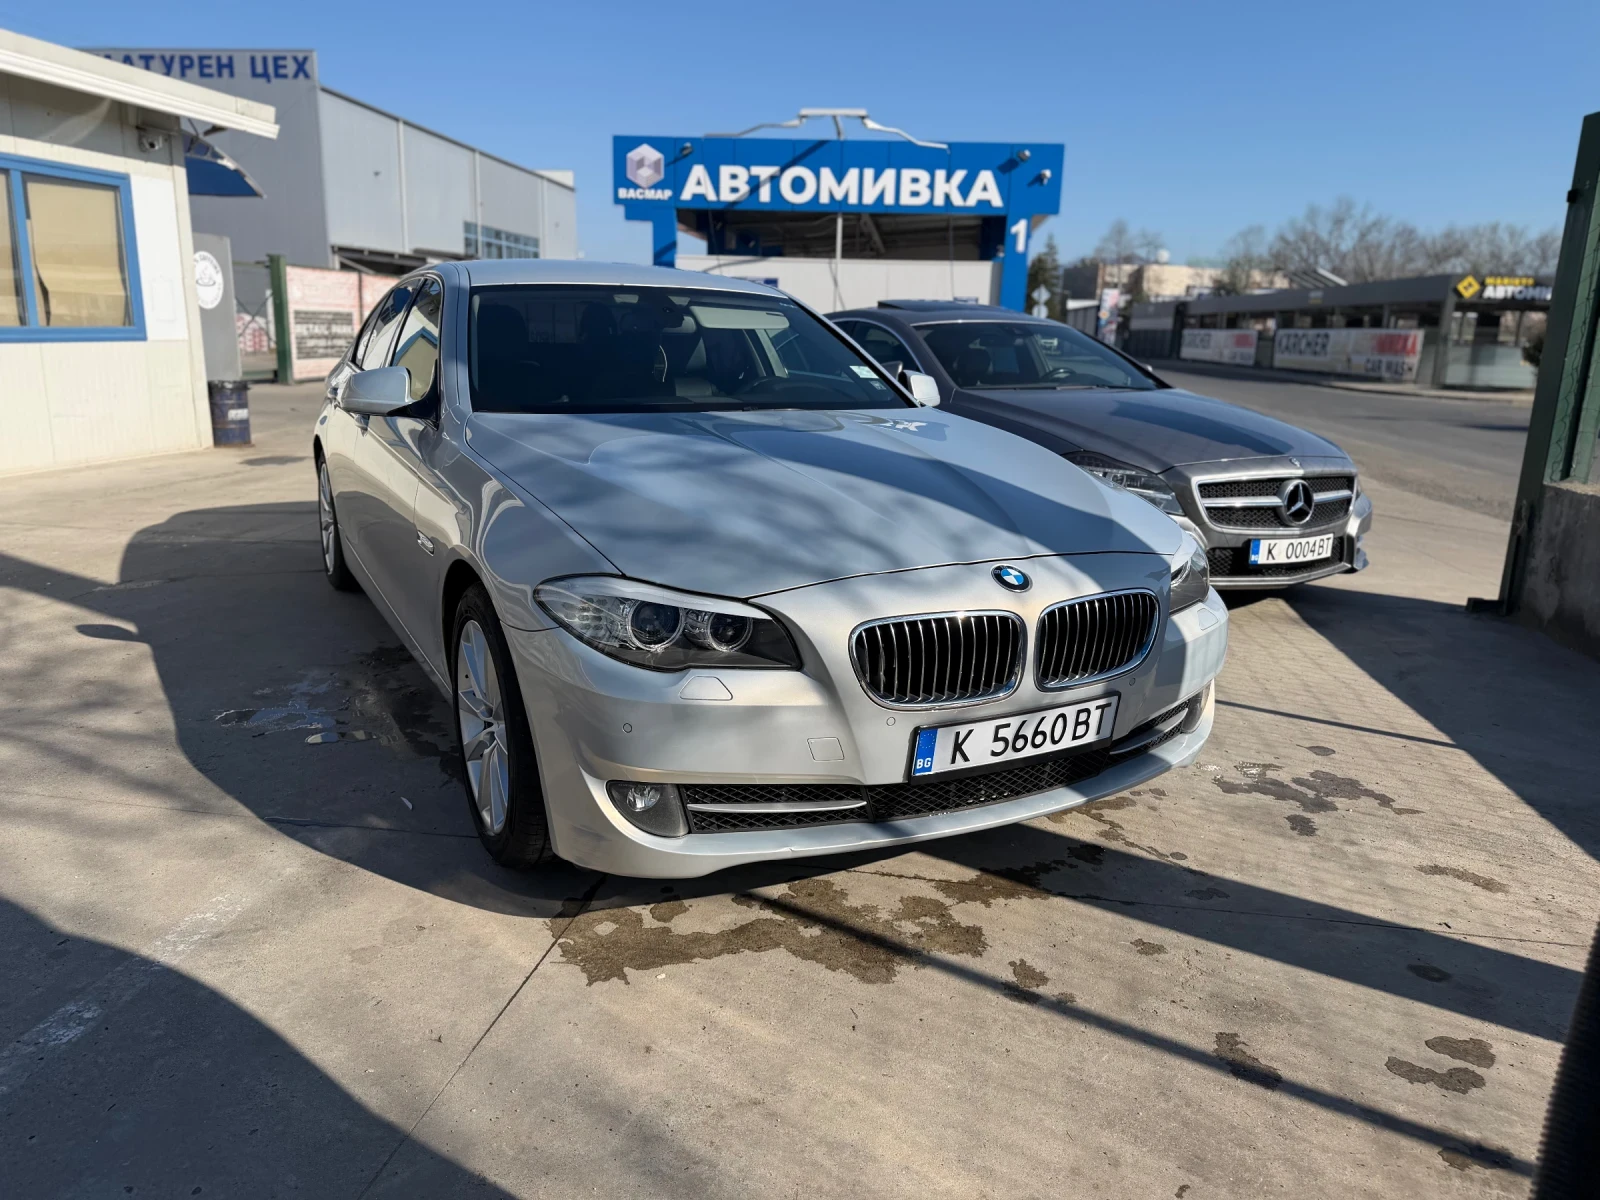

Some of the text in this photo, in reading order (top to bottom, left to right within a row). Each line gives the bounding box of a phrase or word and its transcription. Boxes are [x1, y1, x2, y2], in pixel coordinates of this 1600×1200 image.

[250, 55, 311, 83] ЦЕХ
[617, 188, 673, 200] ВАСМАР
[679, 164, 1004, 208] АВТОМИВКА
[1010, 218, 1028, 254] 1
[1266, 542, 1278, 560] K
[950, 729, 975, 765] K
[916, 757, 932, 770] BG
